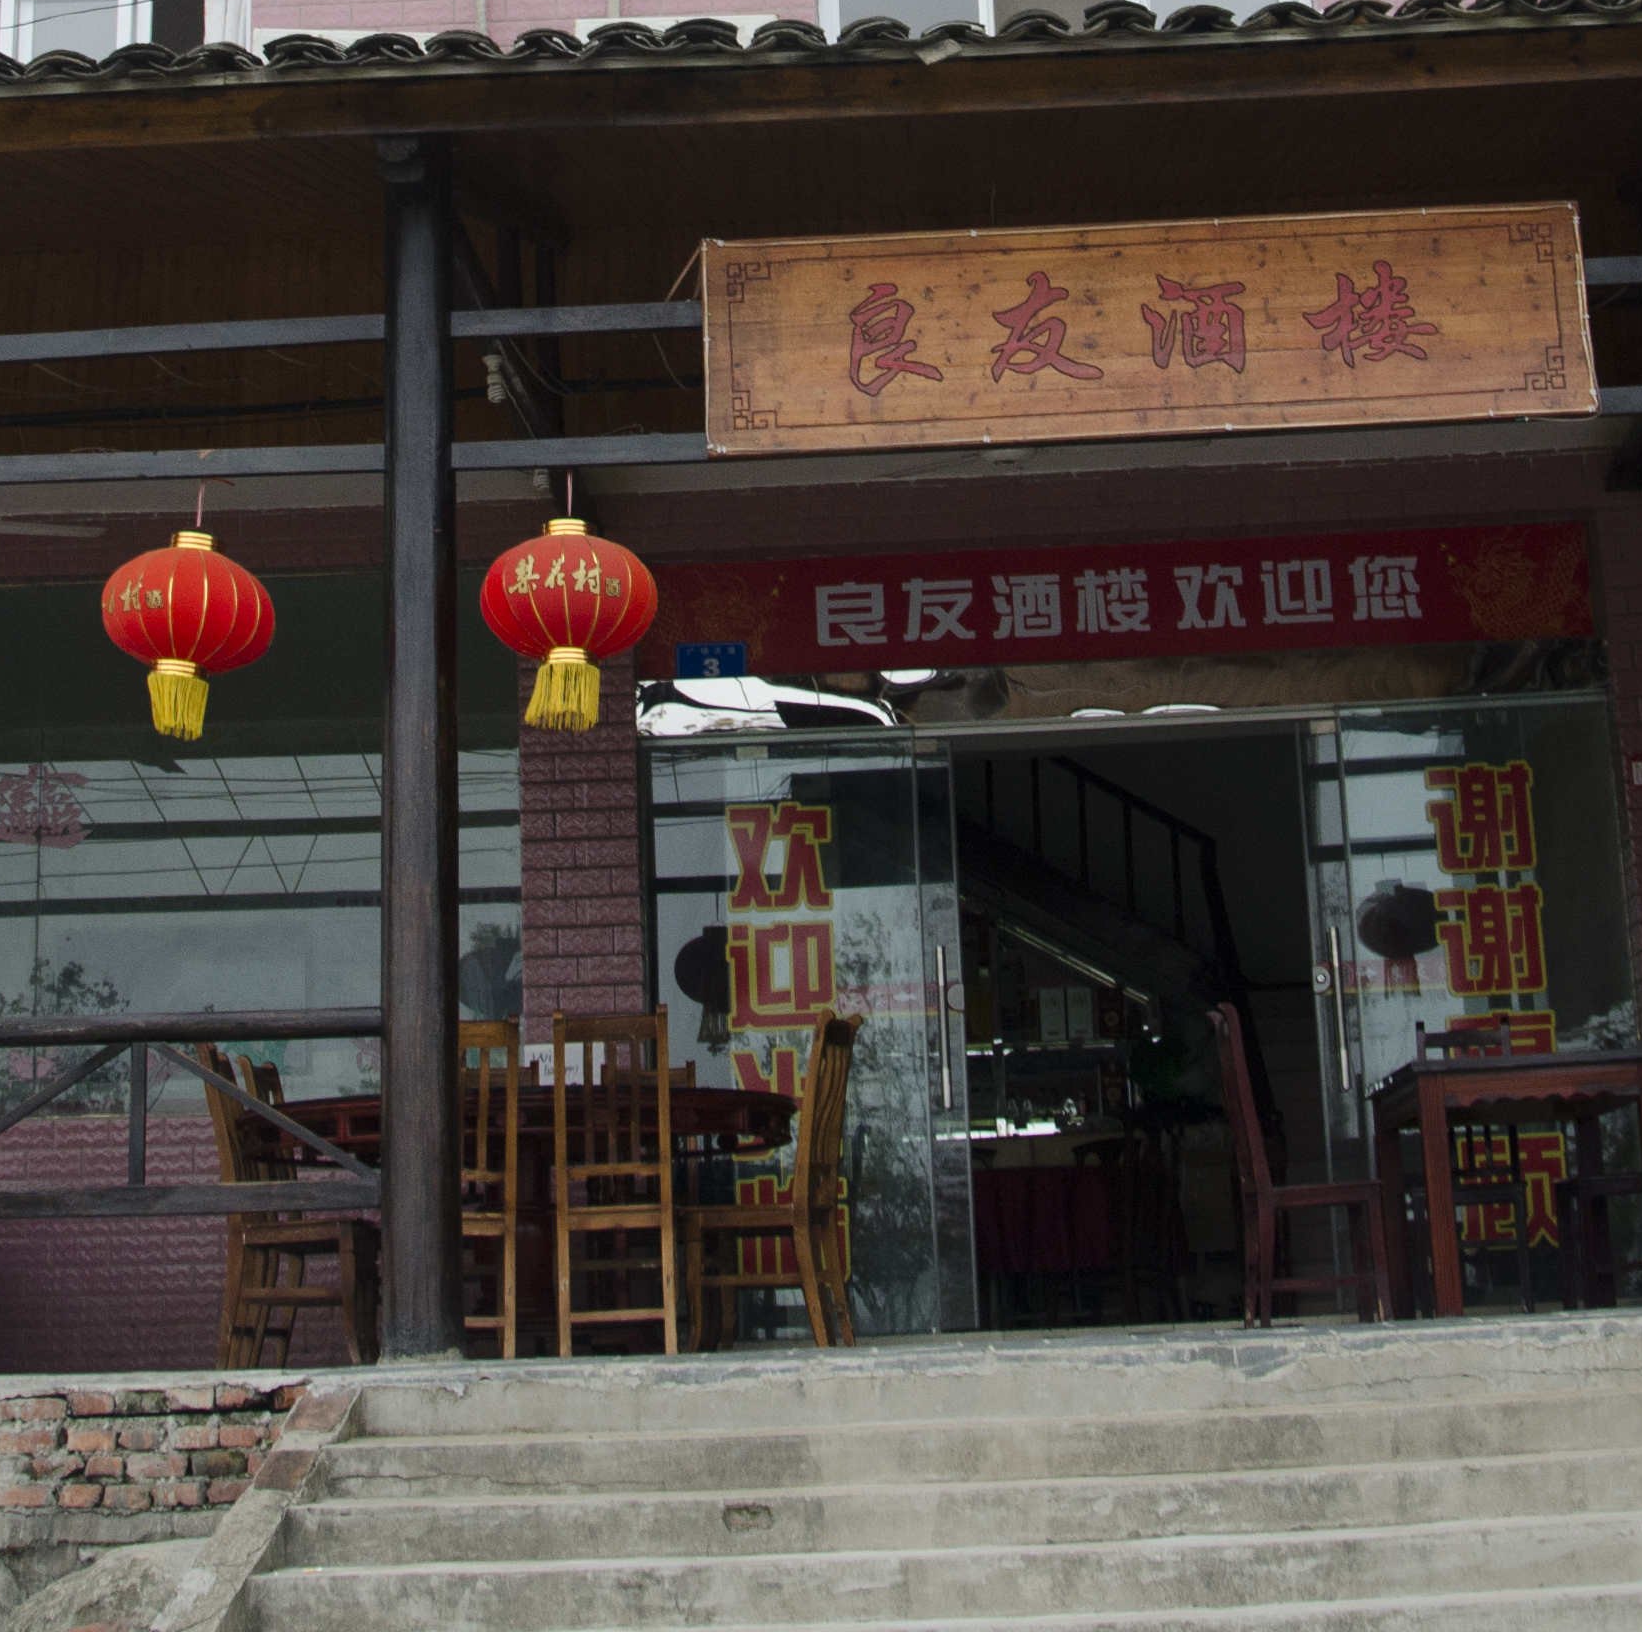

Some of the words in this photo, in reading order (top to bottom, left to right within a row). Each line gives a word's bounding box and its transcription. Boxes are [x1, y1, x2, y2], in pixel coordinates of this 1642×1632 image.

[848, 259, 1438, 396] 良友酒楼
[703, 658, 721, 676] 3
